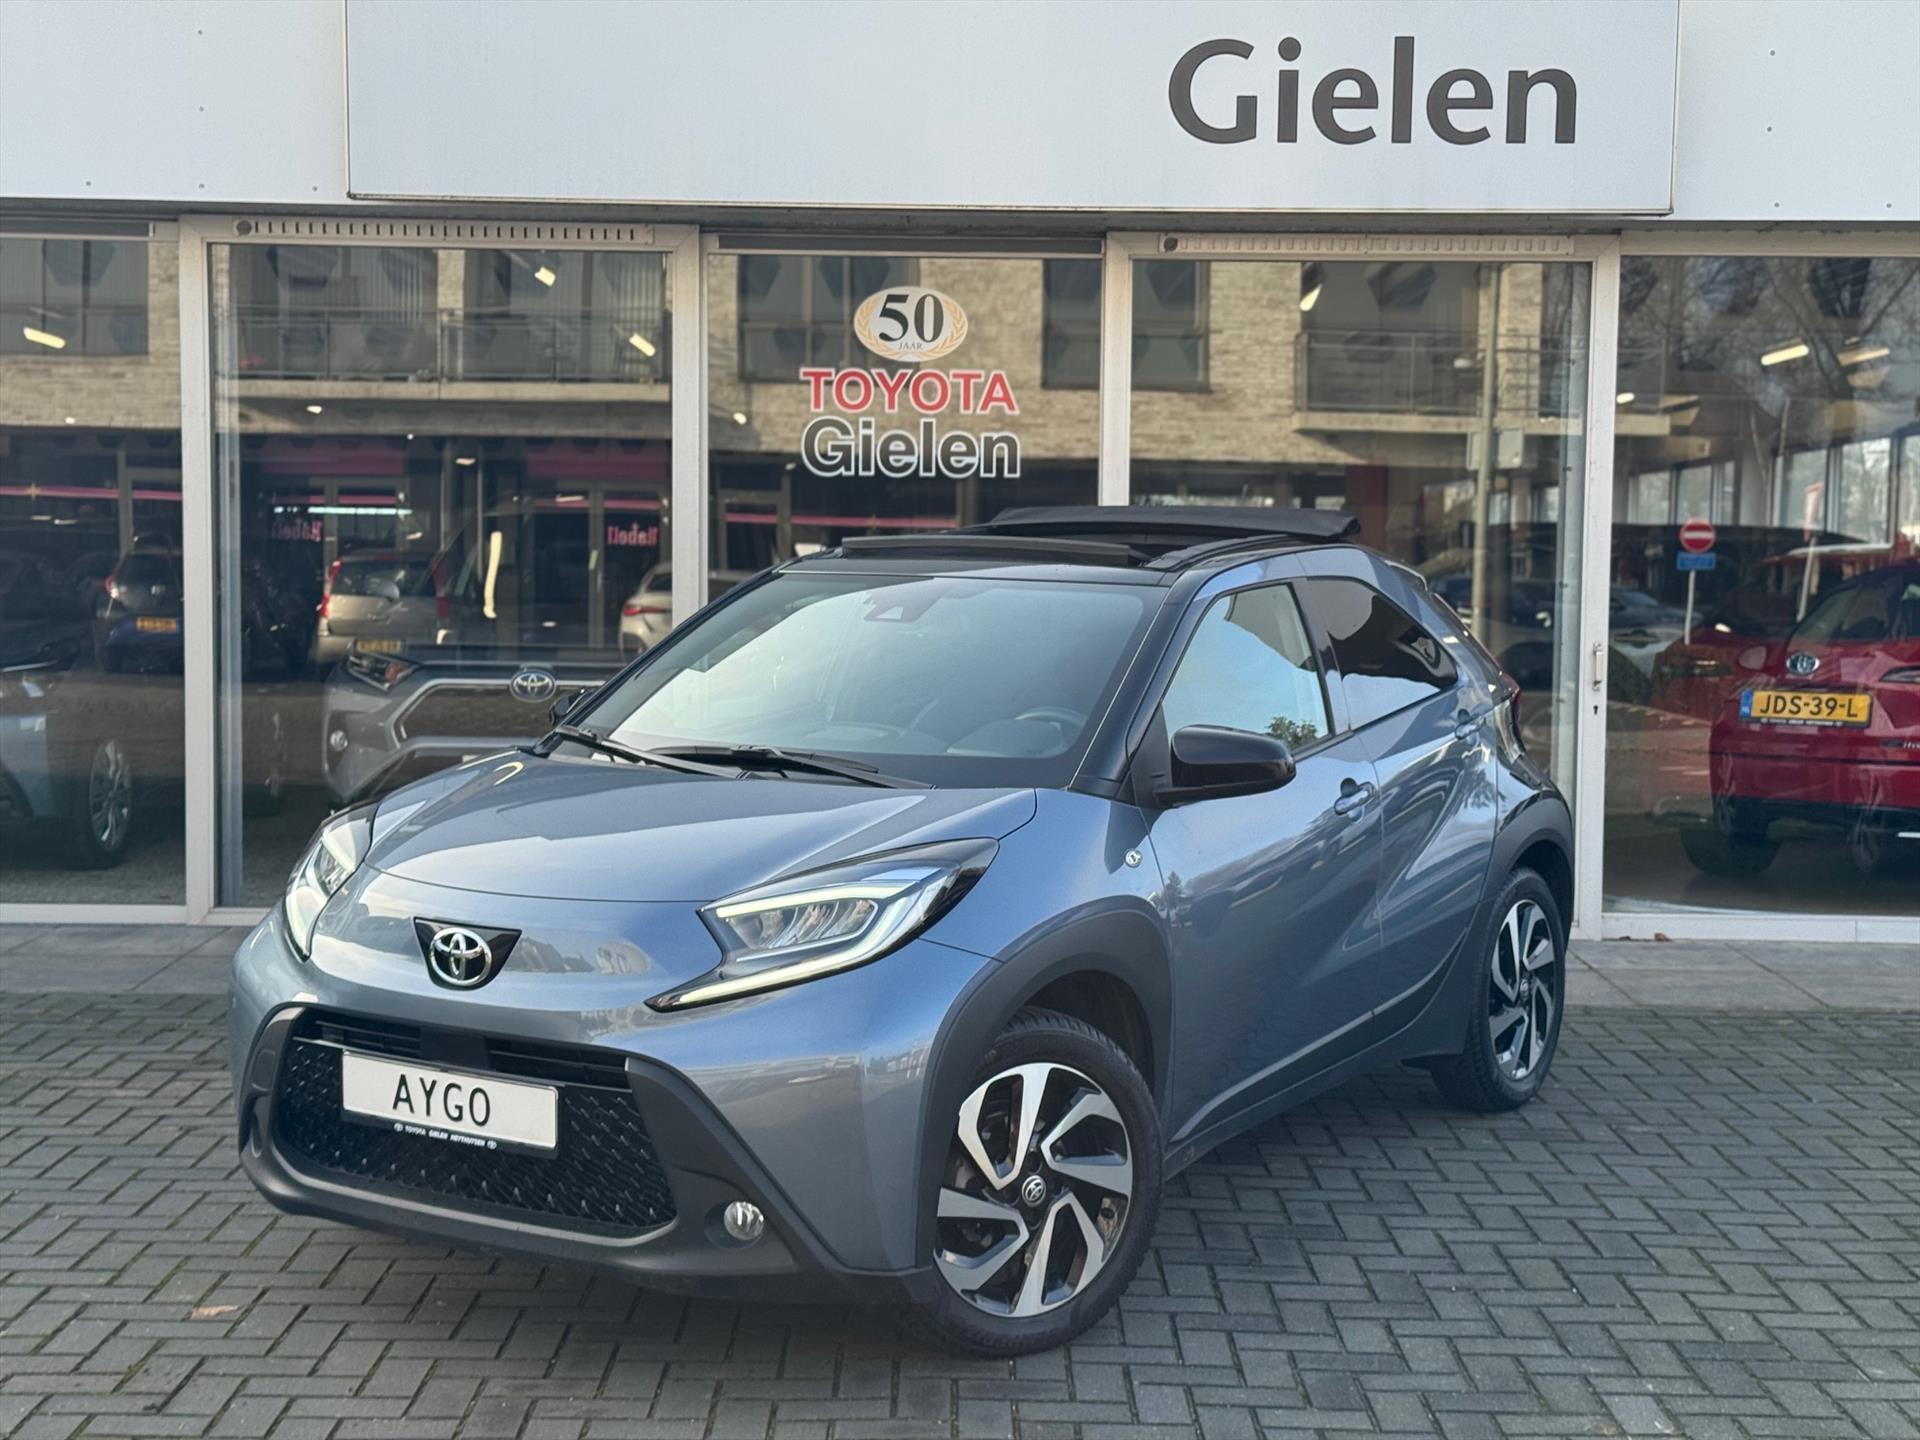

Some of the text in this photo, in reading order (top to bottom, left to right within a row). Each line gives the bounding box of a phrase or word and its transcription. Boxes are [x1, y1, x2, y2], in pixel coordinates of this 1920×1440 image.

[1168, 36, 1577, 145] Gielen
[879, 293, 944, 343] 50
[898, 341, 923, 351] JAAR
[800, 368, 1020, 414] TOYOTA
[801, 415, 1020, 478] Gielen
[1760, 694, 1857, 718] JDS-39-L
[392, 1074, 491, 1126] AYGO
